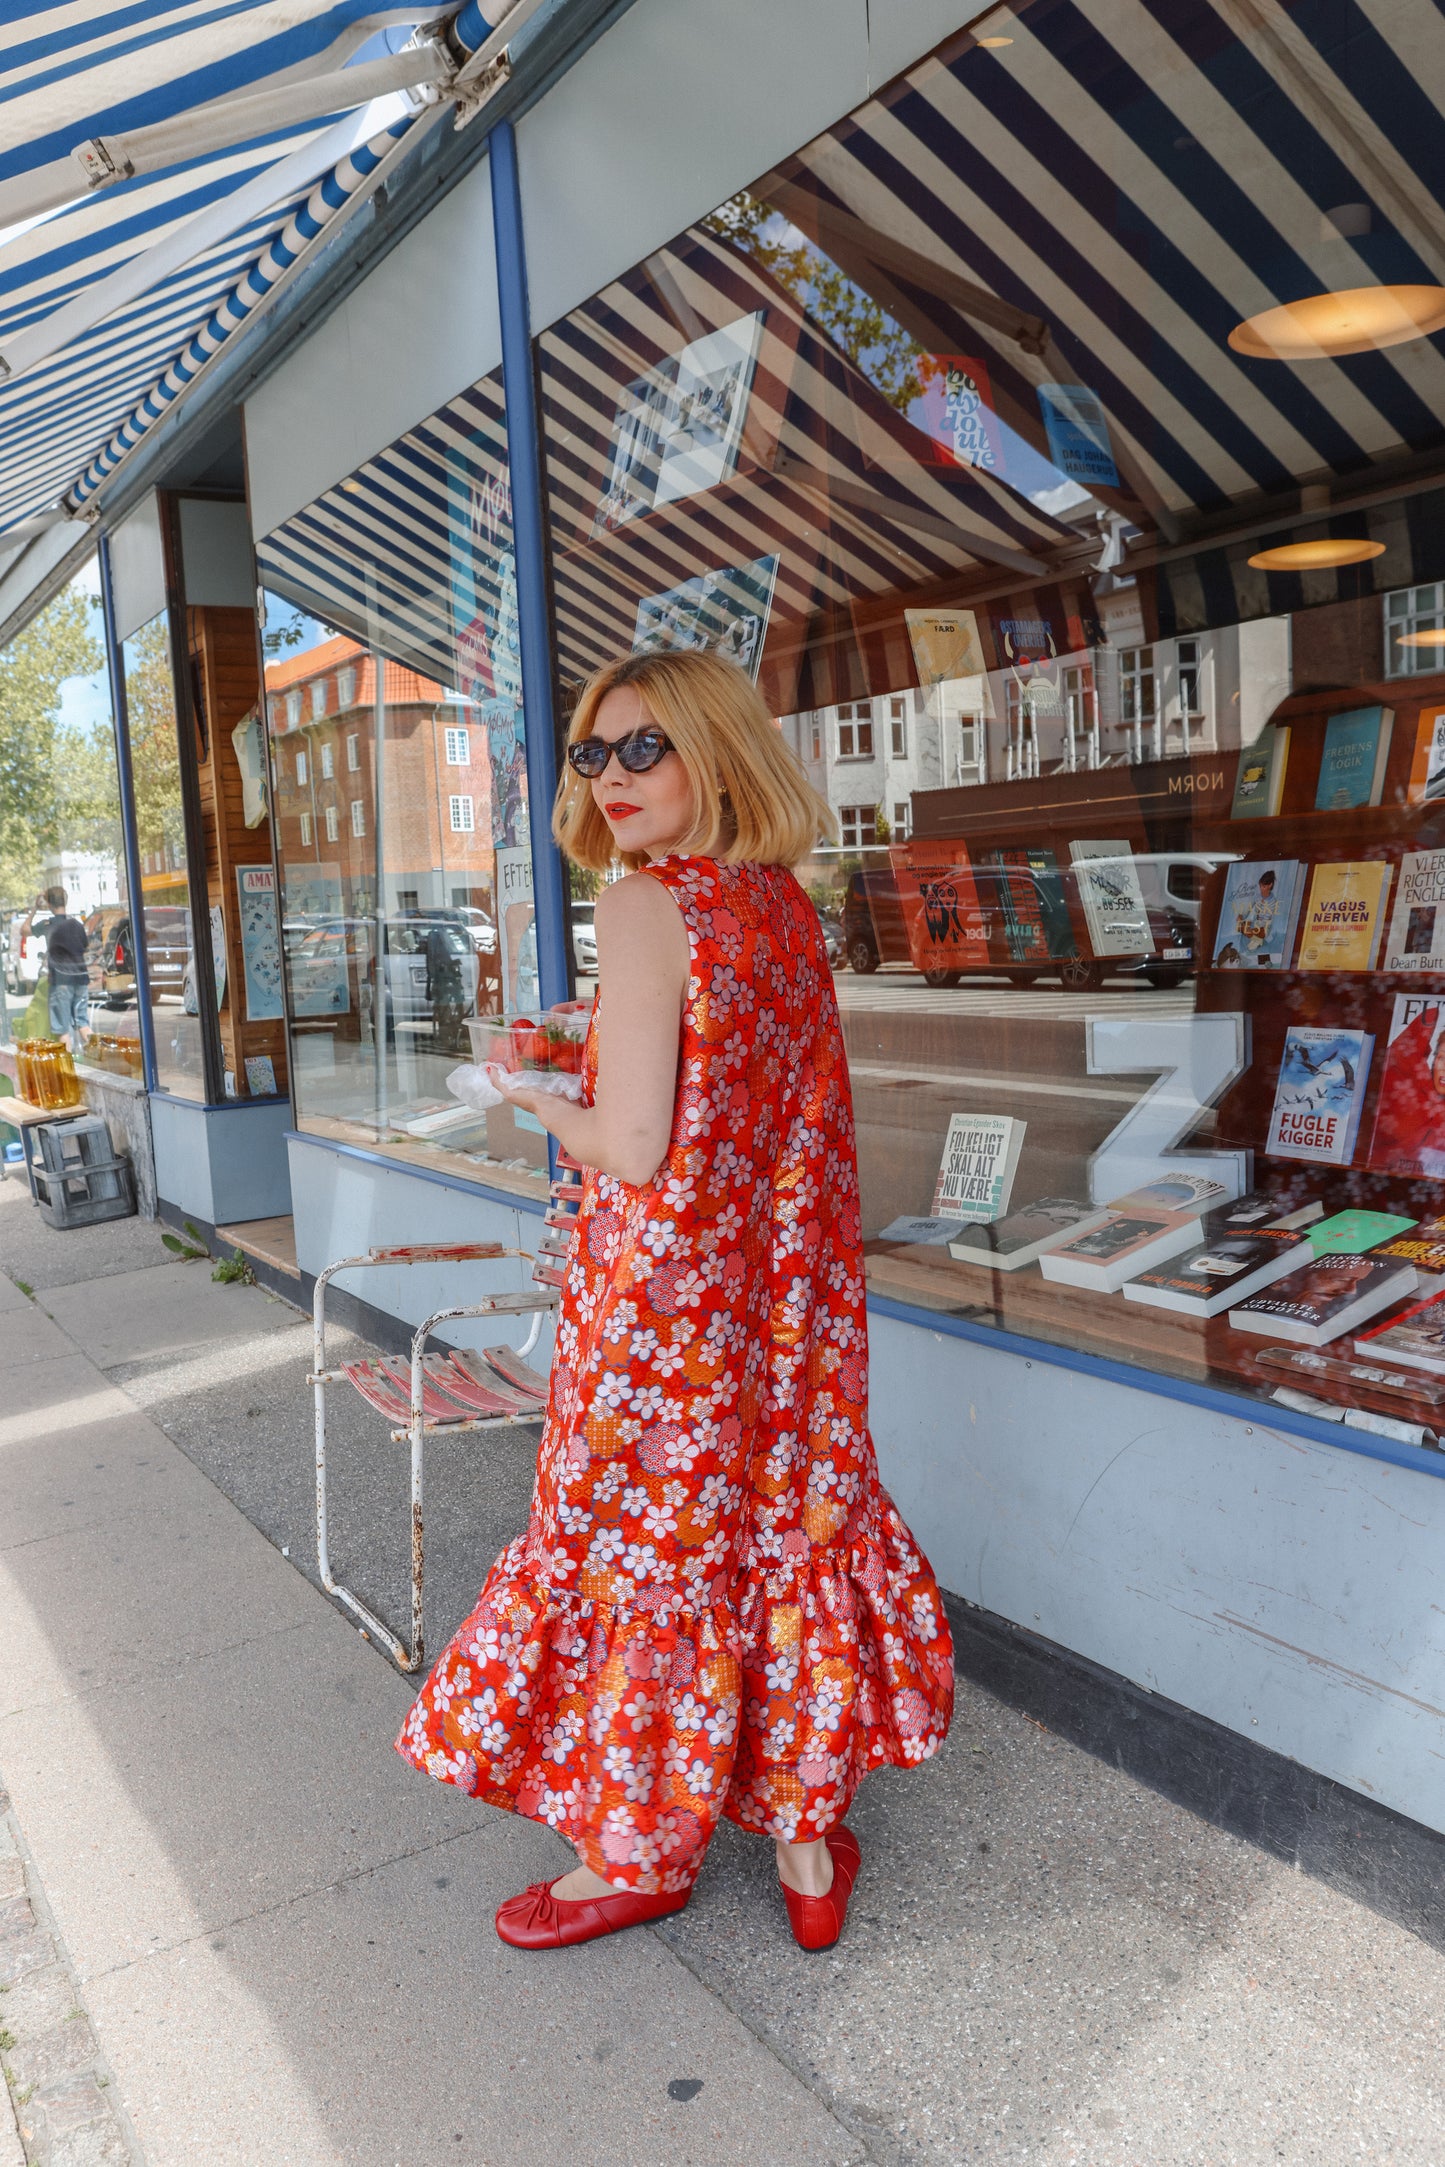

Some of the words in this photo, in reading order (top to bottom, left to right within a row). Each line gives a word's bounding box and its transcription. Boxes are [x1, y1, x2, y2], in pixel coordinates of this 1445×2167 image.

[1324, 741, 1374, 760] FREDENS
[1329, 756, 1362, 771] LOGIK
[1416, 858, 1427, 871] VI
[247, 873, 274, 887] AMA
[1320, 901, 1366, 912] VAGUS
[1313, 911, 1370, 923] NERVEN
[1391, 957, 1417, 969] Dean
[1402, 1000, 1445, 1028] FU
[1281, 1112, 1337, 1134] FUGLE
[948, 1131, 1005, 1156] FOLKELIGT
[1278, 1130, 1334, 1149] KIGGER
[947, 1152, 973, 1177] SKAL
[974, 1155, 996, 1179] ALT
[942, 1174, 959, 1198] NU
[960, 1176, 993, 1202] VÆRE
[1249, 1298, 1317, 1312] UDVALGTE
